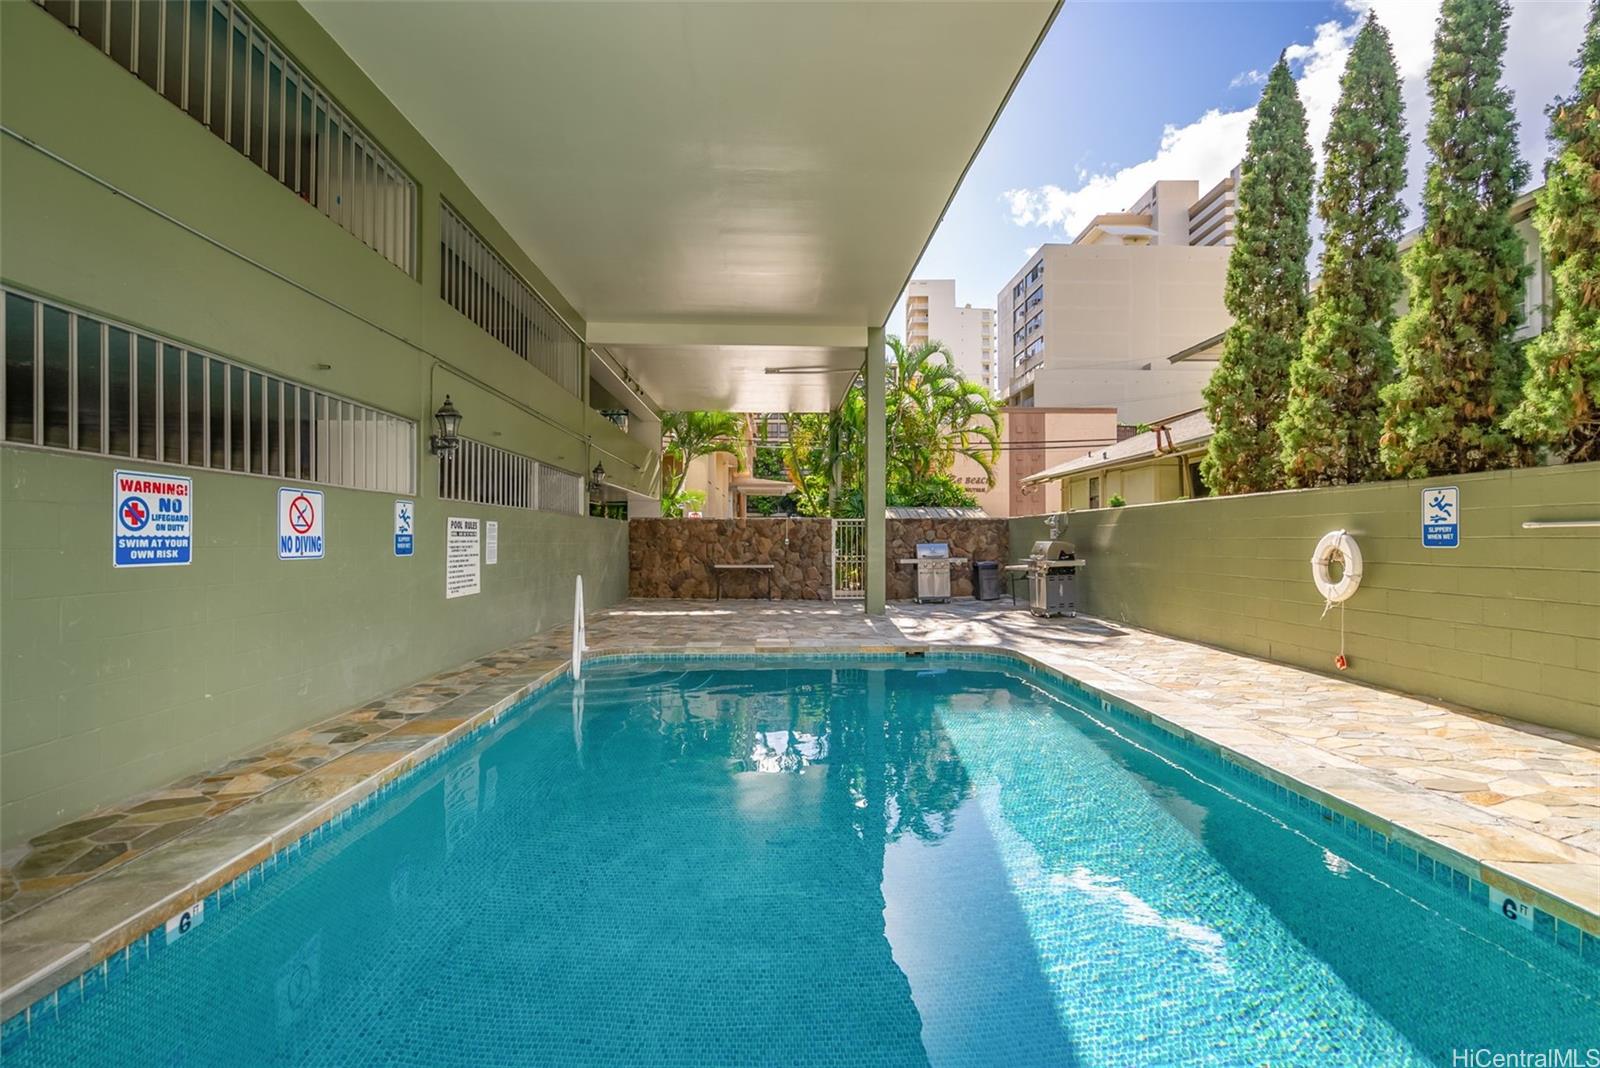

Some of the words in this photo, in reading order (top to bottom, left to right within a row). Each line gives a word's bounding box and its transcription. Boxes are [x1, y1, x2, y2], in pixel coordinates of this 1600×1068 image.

[120, 479, 188, 496] WARNING!
[159, 498, 182, 513] NO
[151, 514, 188, 522] LIFEGUARD
[156, 523, 166, 531] ON
[167, 523, 184, 531] DUTY
[451, 521, 462, 530] POOL
[465, 522, 477, 530] RULES
[118, 538, 149, 548] SWIM
[150, 538, 163, 548] AT
[164, 538, 188, 548] YOUR
[281, 535, 293, 554] NO
[295, 535, 322, 553] DIVING
[130, 549, 155, 559] OWN
[156, 548, 179, 558] RISK
[1503, 899, 1517, 920] 6
[179, 912, 191, 934] 6
